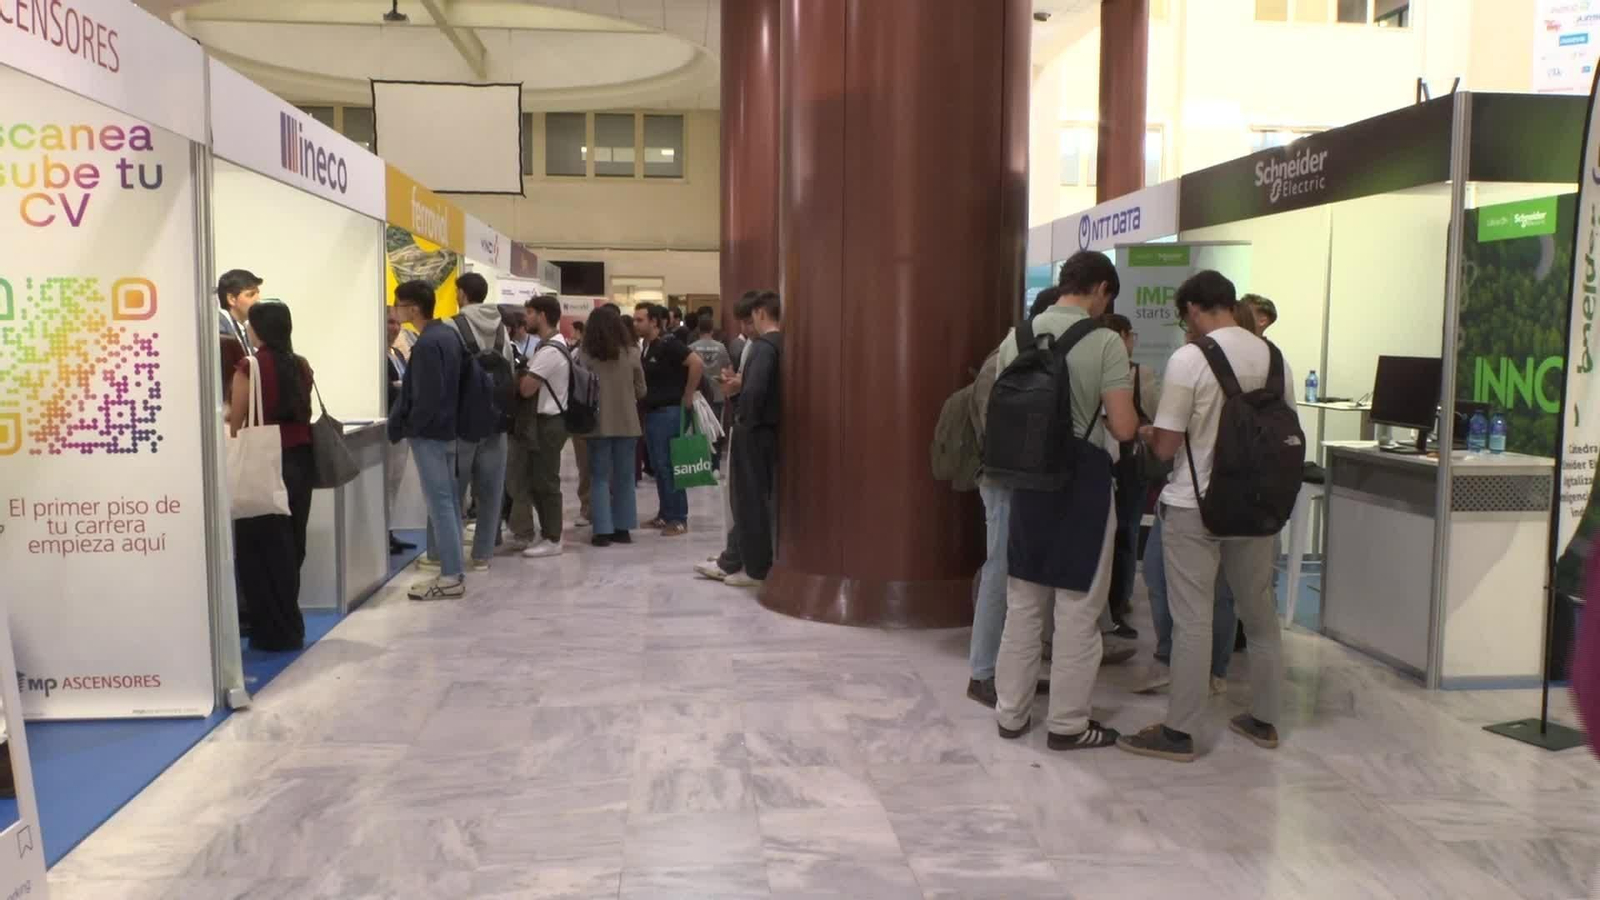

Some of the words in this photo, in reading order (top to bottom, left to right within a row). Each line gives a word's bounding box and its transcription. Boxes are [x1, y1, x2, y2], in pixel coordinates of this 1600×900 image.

[0, 122, 154, 152] canea
[299, 122, 348, 194] ineco
[1254, 146, 1328, 187] Schneider
[0, 154, 101, 190] ube
[115, 157, 164, 190] tu
[1282, 176, 1326, 198] Electric
[19, 192, 91, 228] CV
[1091, 215, 1111, 241] NTT
[1135, 307, 1171, 319] starts
[673, 457, 711, 476] sando
[9, 497, 26, 518] El
[33, 497, 101, 521] primer
[107, 496, 149, 520] piso
[155, 495, 181, 515] de
[47, 518, 68, 535] tu
[75, 519, 146, 535] carrera
[28, 535, 115, 557] empieza
[121, 533, 166, 556] aquí
[61, 674, 162, 690] ASCENSORES
